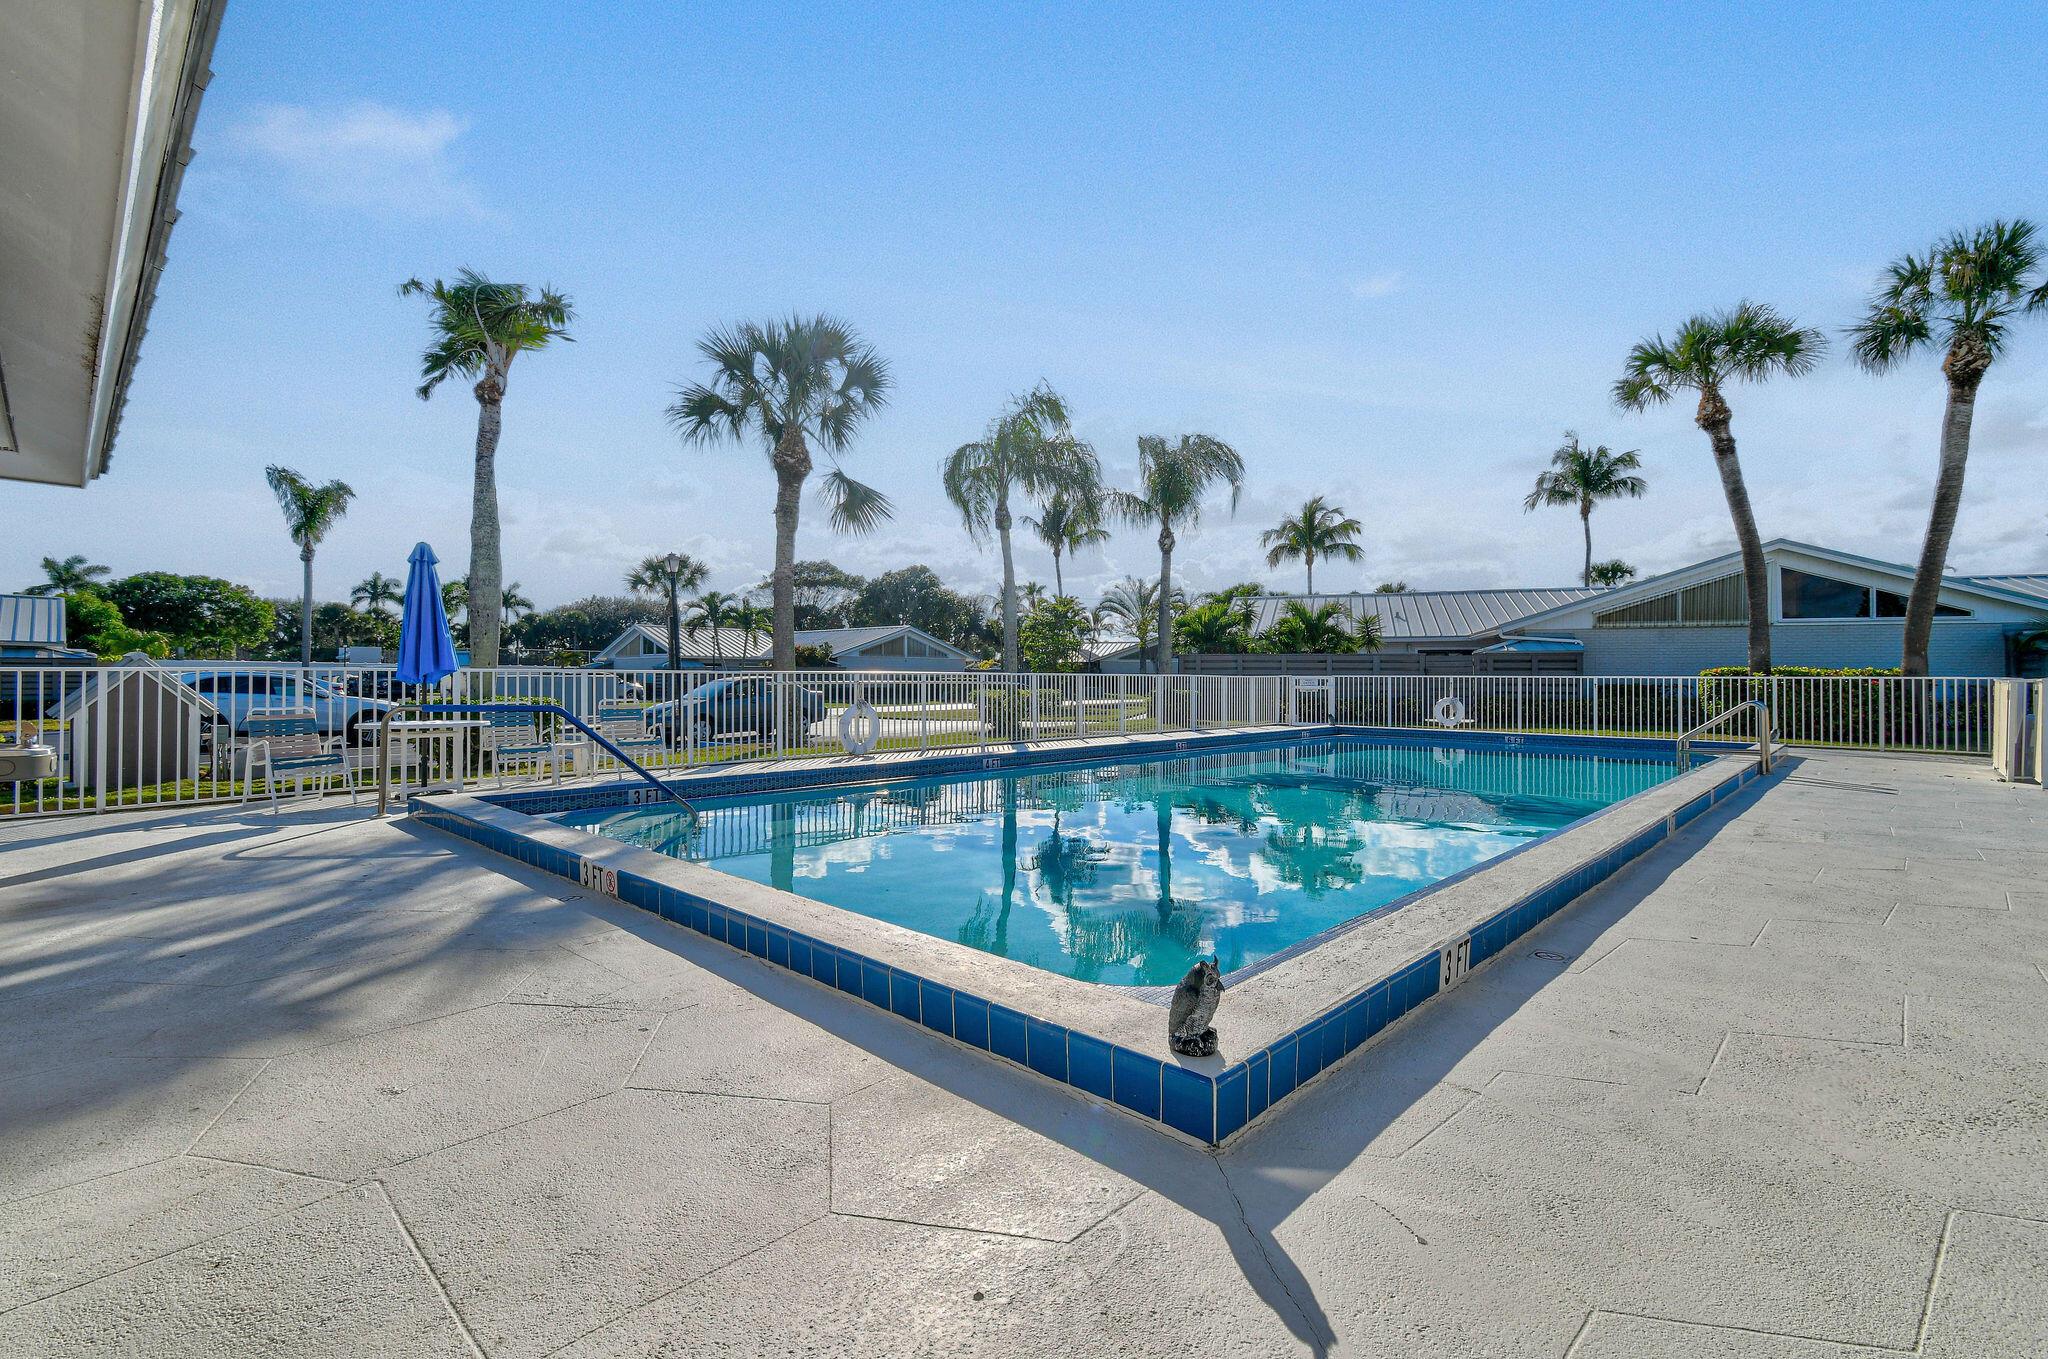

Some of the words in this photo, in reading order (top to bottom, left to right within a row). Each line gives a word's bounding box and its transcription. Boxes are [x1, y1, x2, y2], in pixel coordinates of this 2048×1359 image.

[633, 790, 641, 805] 3
[645, 789, 658, 803] FT
[583, 861, 589, 886] 3
[592, 865, 604, 893] FT
[1444, 949, 1451, 985] 3
[1456, 938, 1469, 978] FT
